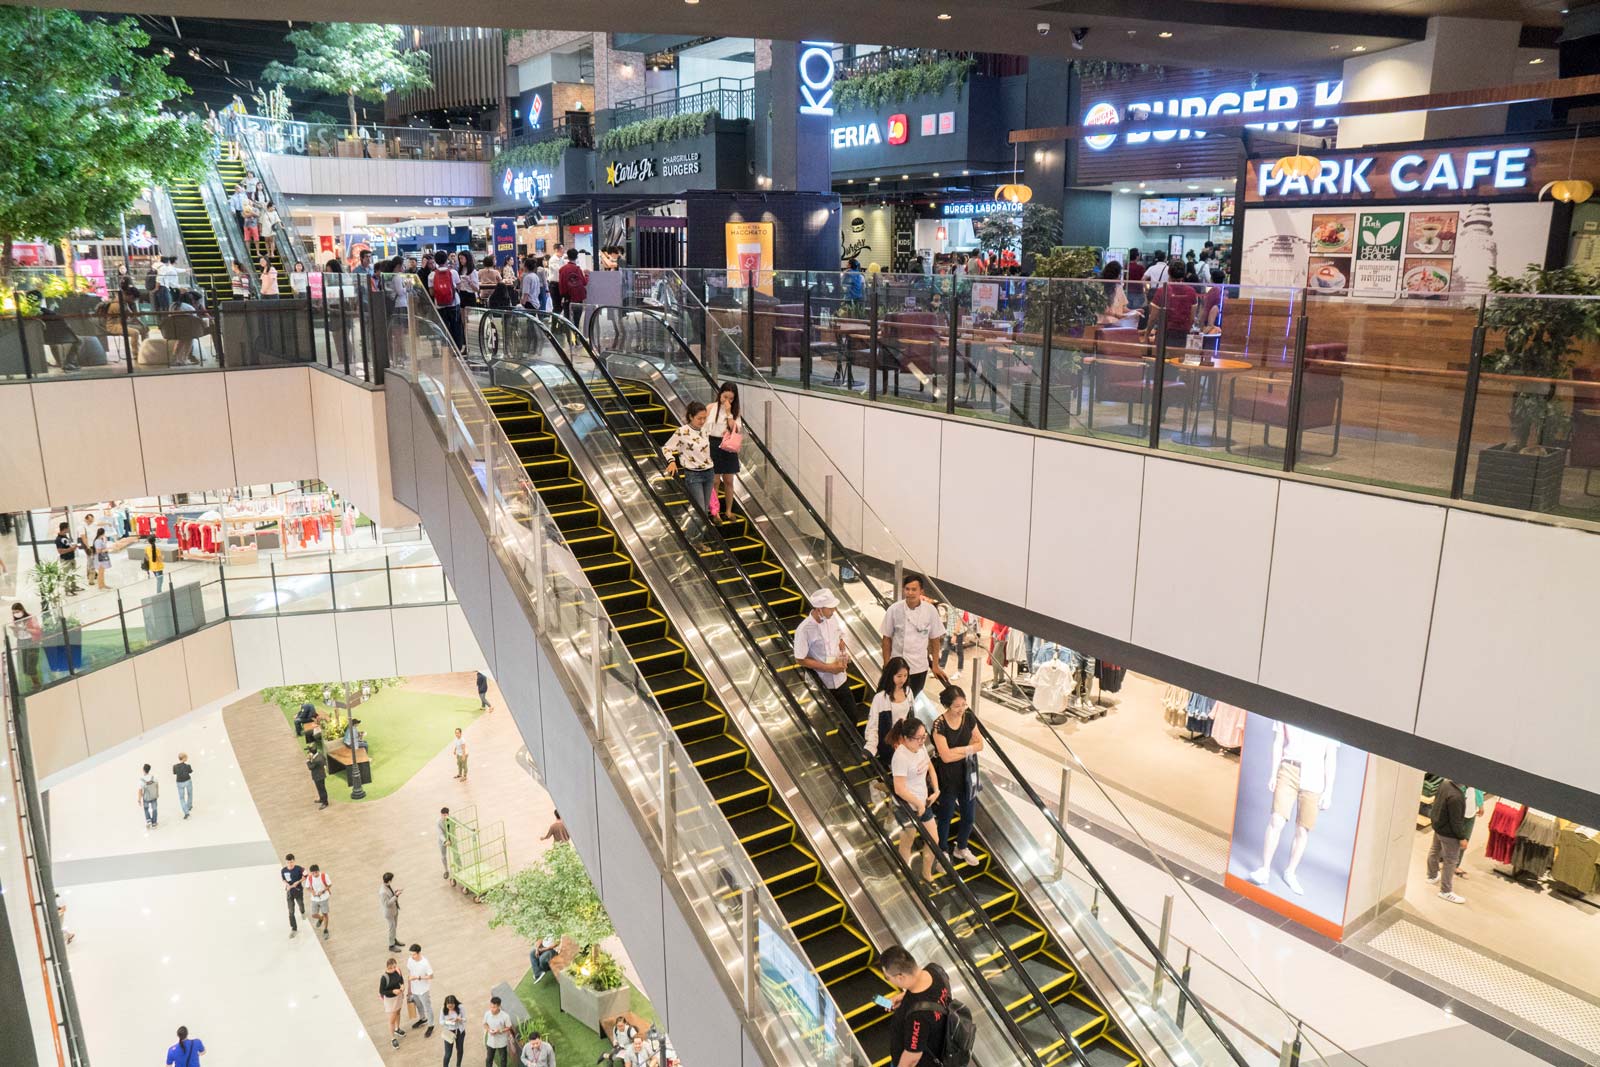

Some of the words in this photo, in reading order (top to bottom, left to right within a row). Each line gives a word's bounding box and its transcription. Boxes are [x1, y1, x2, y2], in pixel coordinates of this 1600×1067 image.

[830, 122, 881, 149] ERIA
[662, 153, 699, 165] CHARGRILLED
[614, 160, 638, 184] Carl's
[638, 157, 654, 182] Jr.
[662, 162, 699, 177] BURGERS
[1258, 157, 1375, 196] PARK
[1389, 147, 1531, 192] CAFE
[944, 205, 974, 215] BURGER
[1360, 252, 1391, 261] CHOICE
[1361, 245, 1398, 254] HEALTHY
[910, 1020, 921, 1050] IMPACT
